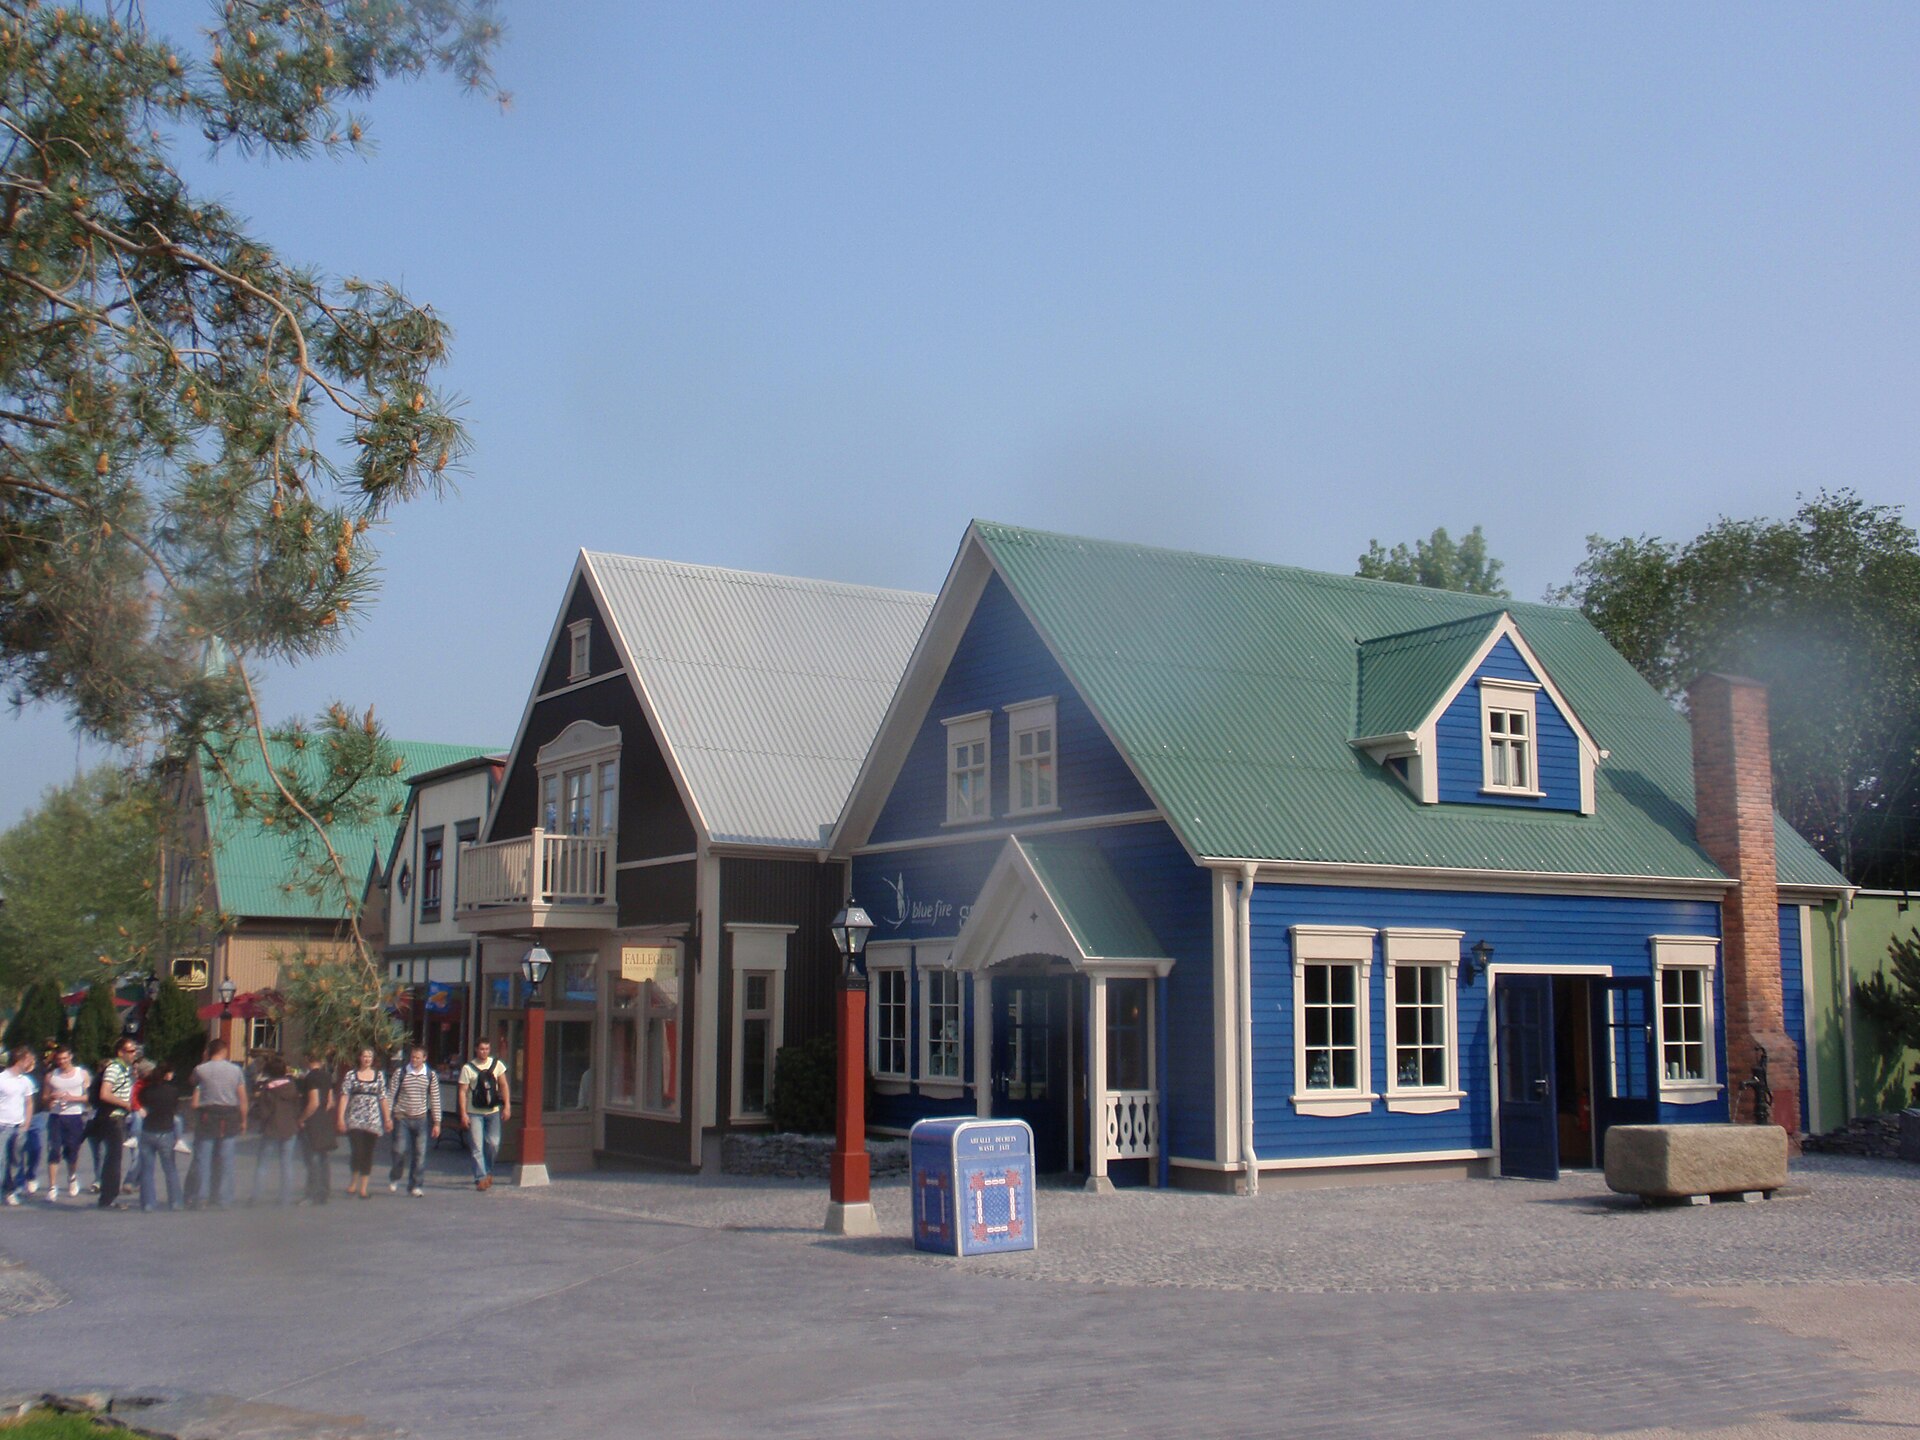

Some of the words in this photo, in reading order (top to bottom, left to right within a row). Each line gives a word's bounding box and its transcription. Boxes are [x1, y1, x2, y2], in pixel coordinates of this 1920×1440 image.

[911, 901, 933, 919] blue
[931, 900, 952, 927] fire
[624, 953, 673, 966] FALLEGUR
